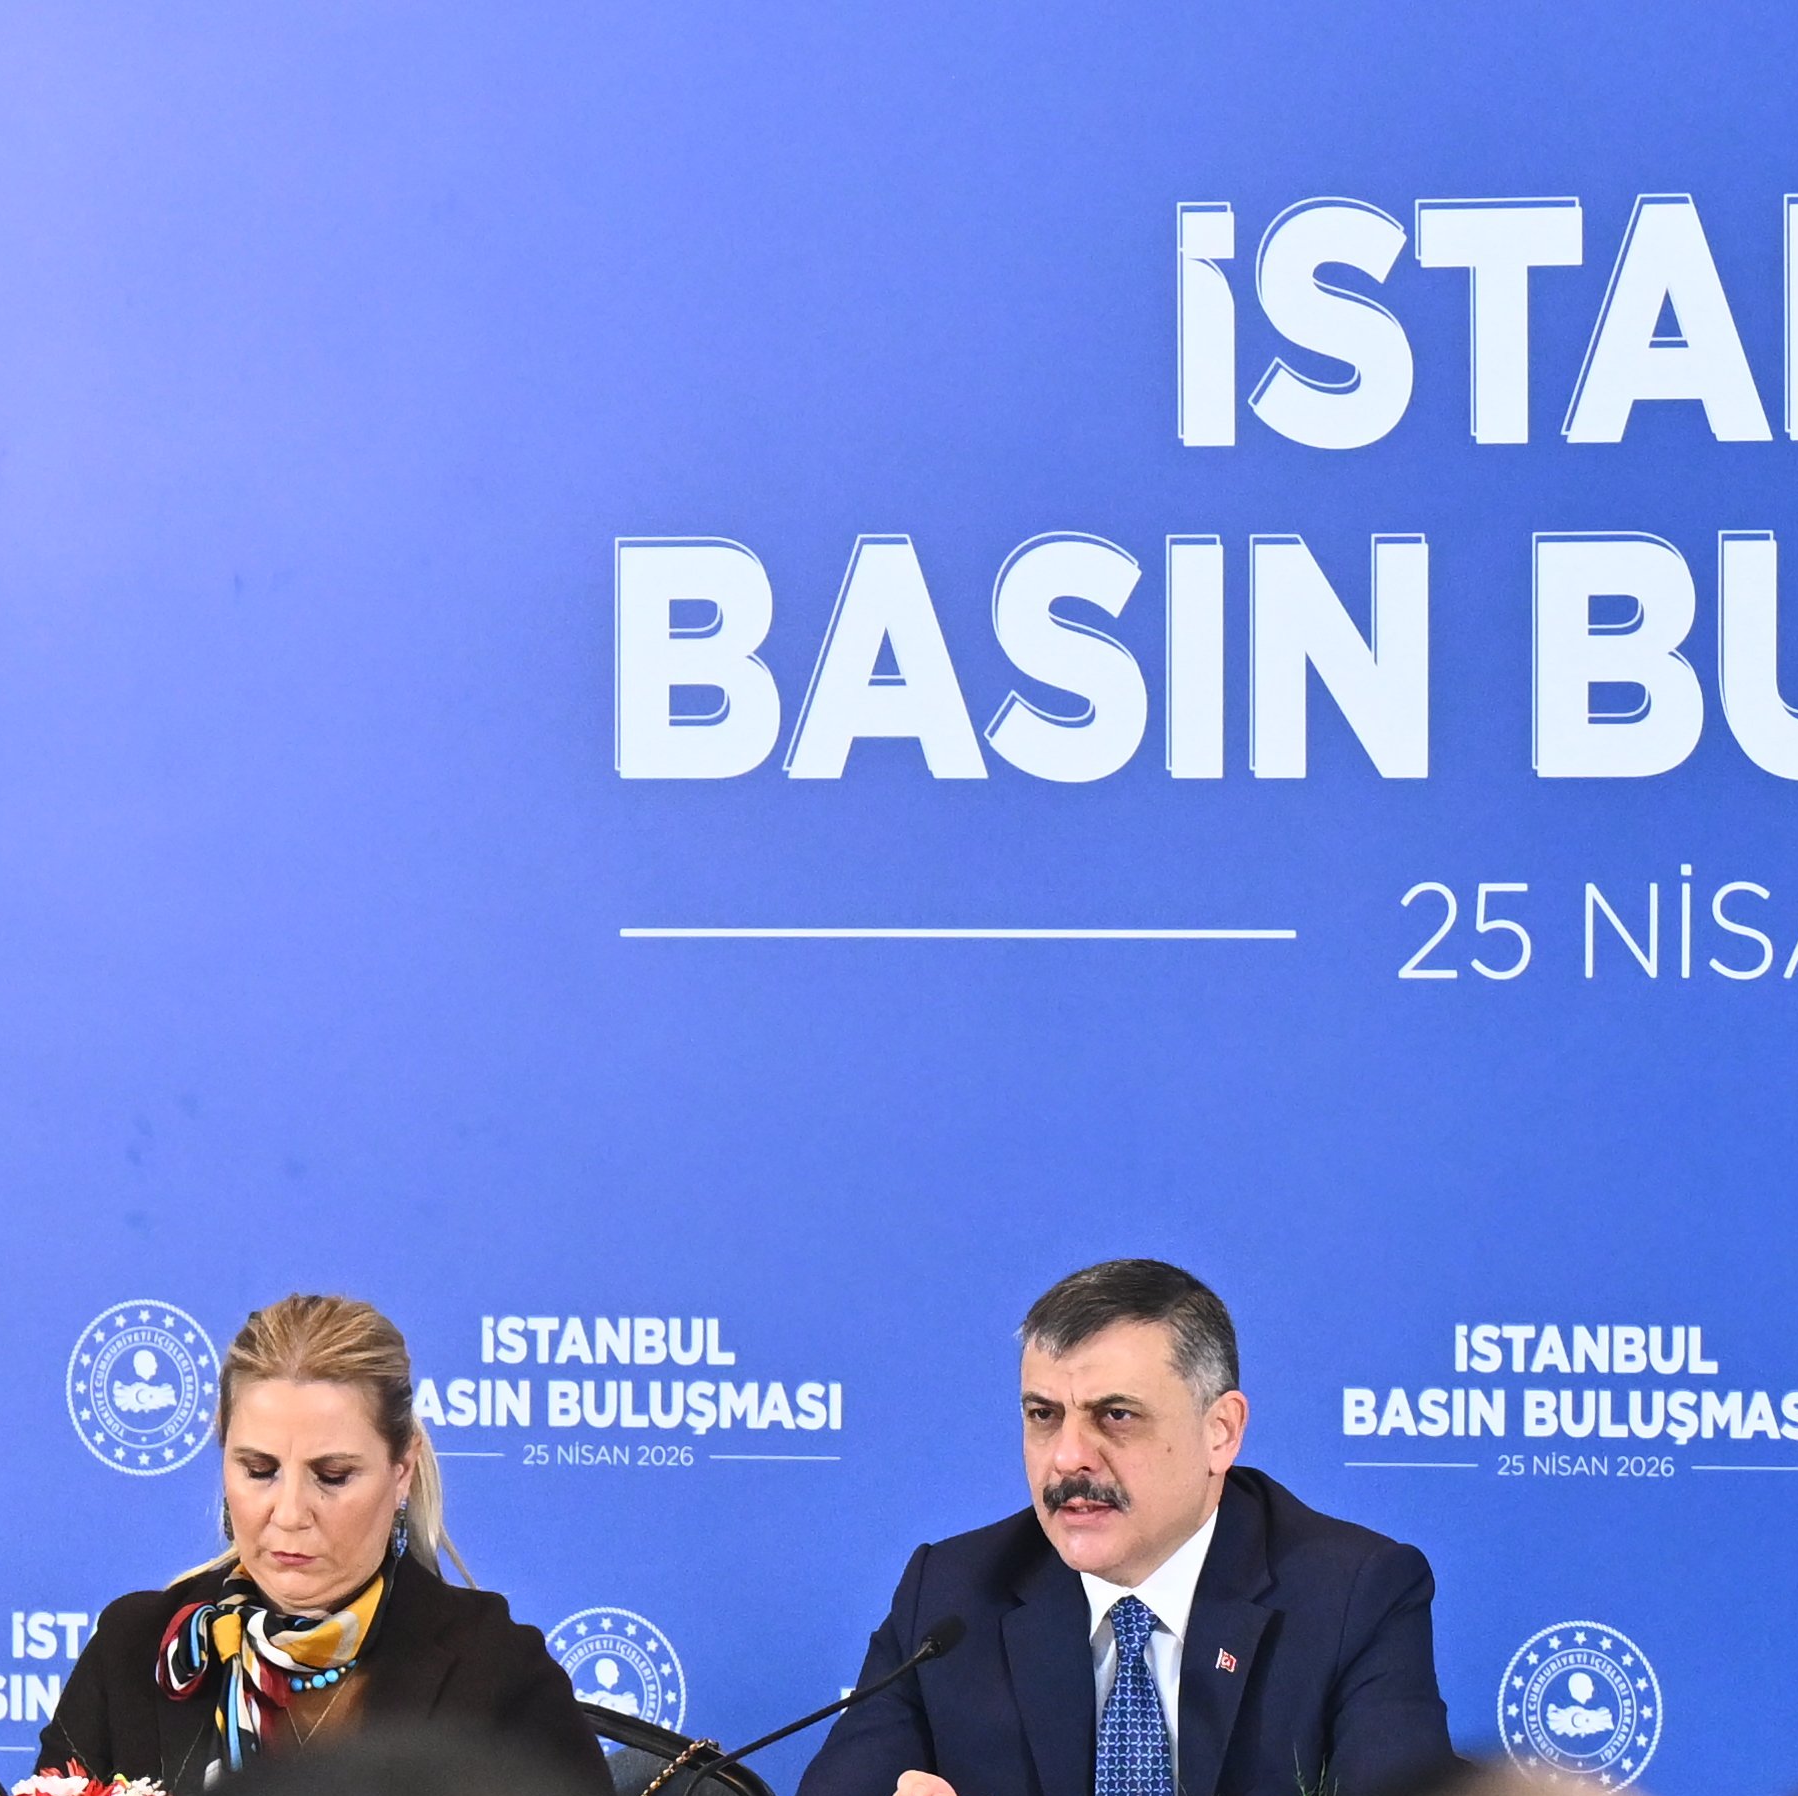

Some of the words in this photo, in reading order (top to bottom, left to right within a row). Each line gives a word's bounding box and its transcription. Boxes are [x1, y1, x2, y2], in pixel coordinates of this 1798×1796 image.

[615, 531, 1428, 782] BASIN
[1399, 880, 1532, 980] 25
[481, 1316, 736, 1366] İSTANBUL
[1455, 1324, 1718, 1375] İSTANBUL
[412, 1378, 531, 1427] ASIN
[548, 1380, 842, 1435] BULUŞMASI
[1343, 1387, 1505, 1437] BASIN
[522, 1444, 550, 1466] 25
[557, 1441, 630, 1466] NİSAN
[637, 1445, 694, 1467] 2026
[1497, 1454, 1525, 1477] 25
[1533, 1451, 1608, 1477] NİSAN
[1616, 1455, 1675, 1478] 2026
